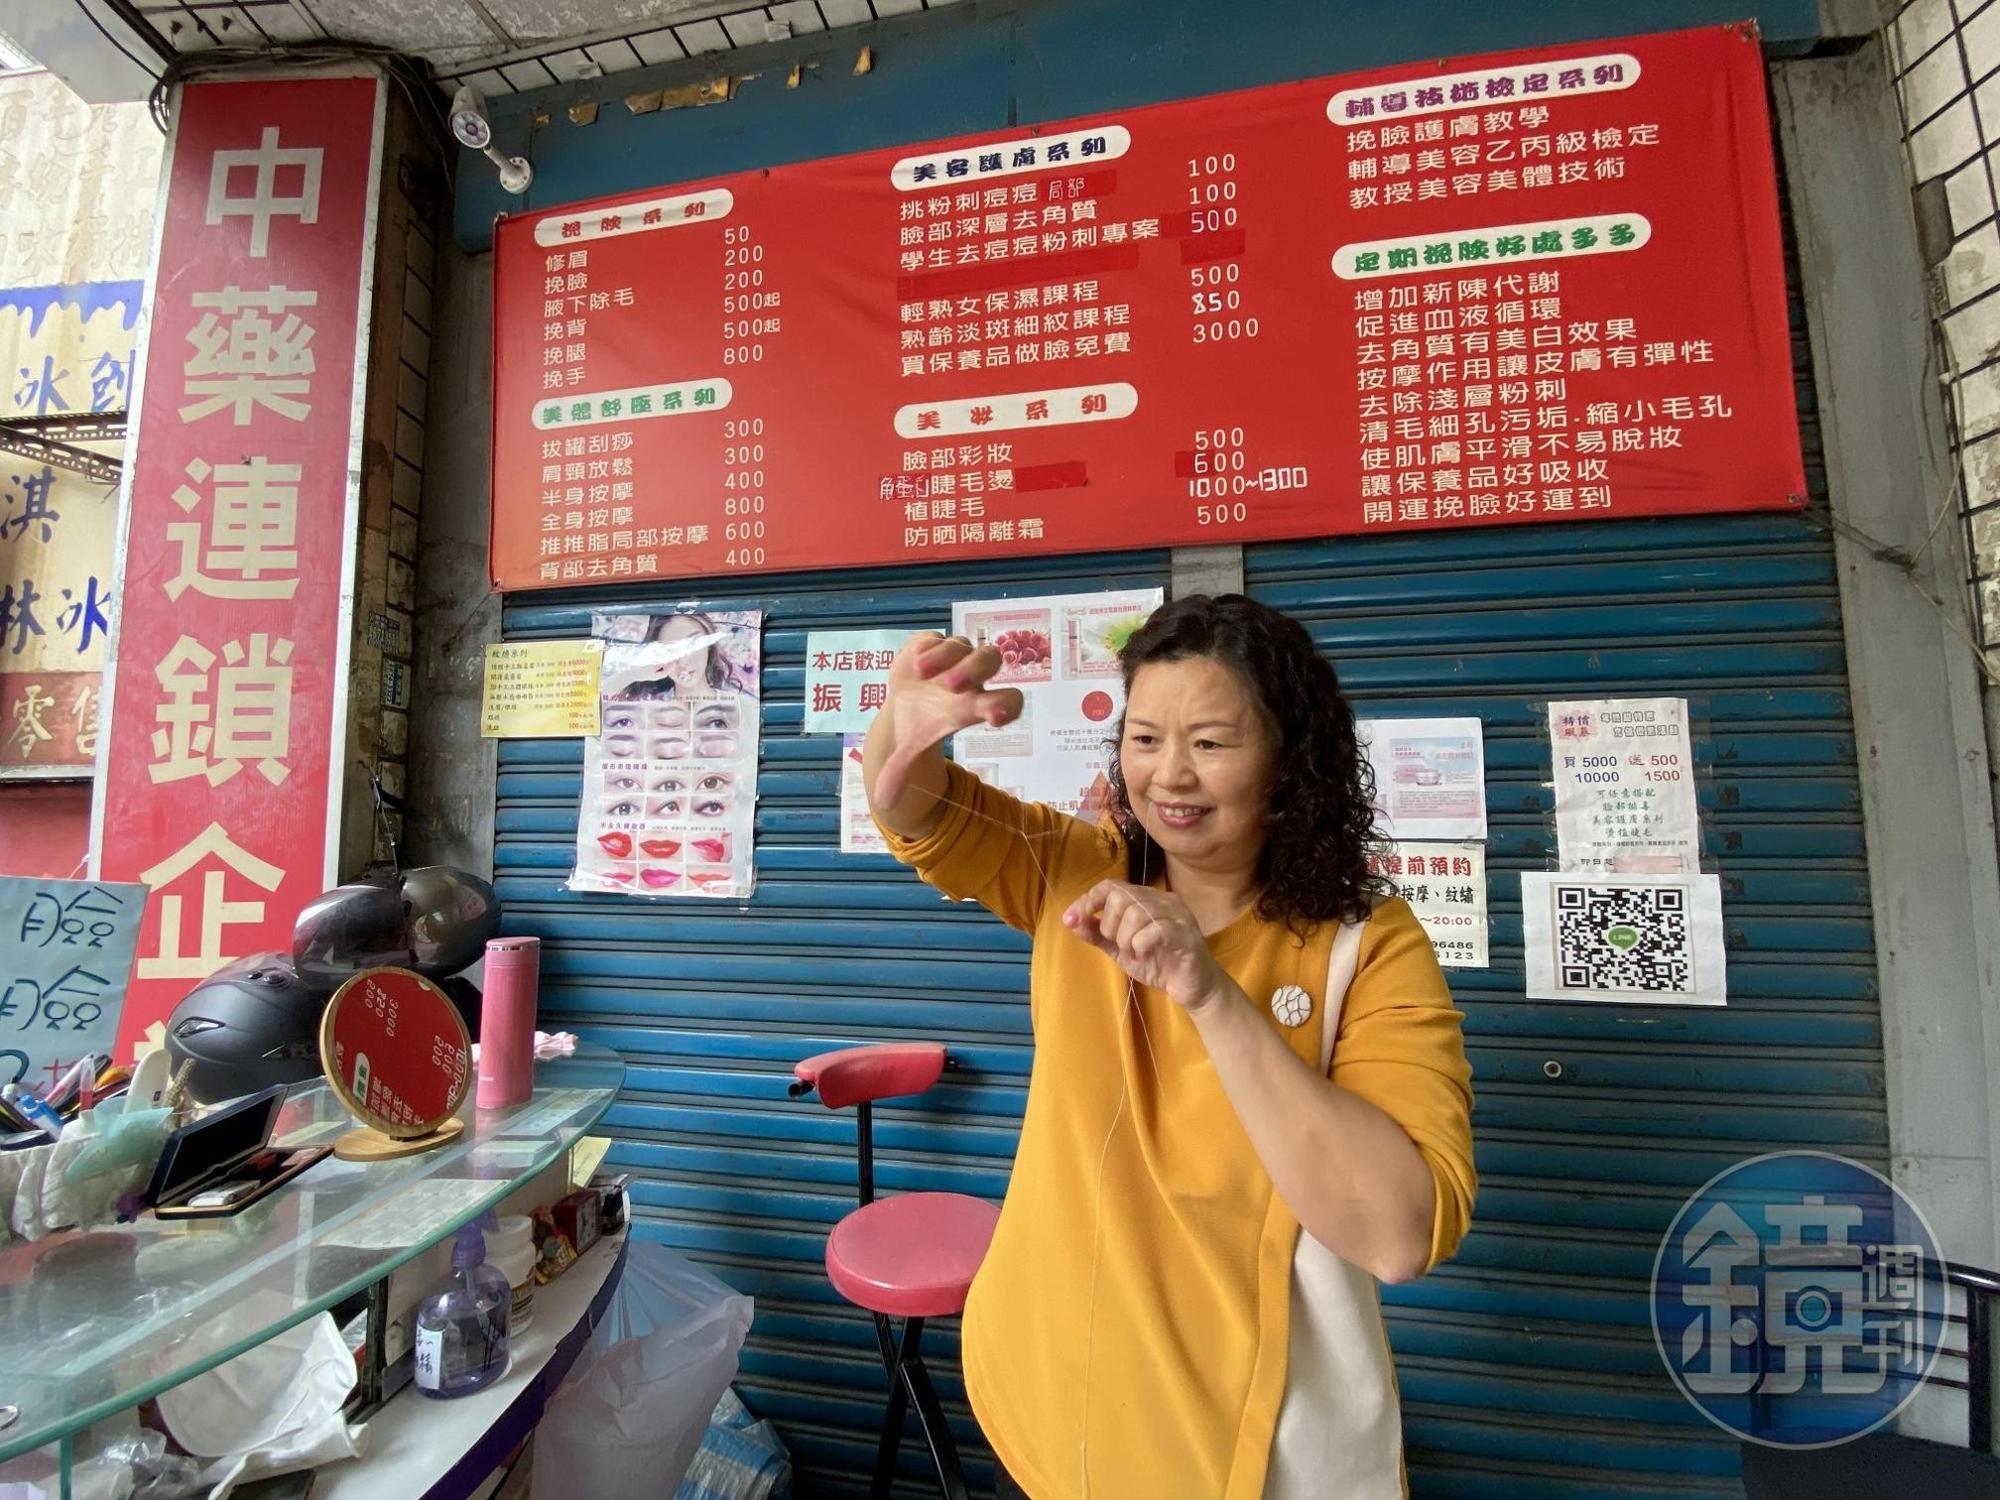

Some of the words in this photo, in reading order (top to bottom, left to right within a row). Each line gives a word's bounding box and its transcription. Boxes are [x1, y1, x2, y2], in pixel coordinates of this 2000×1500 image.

[1347, 106, 1550, 152] 挽臉護膚教學
[913, 136, 1106, 182] 美容護膚系列
[1189, 153, 1236, 178] 100
[1348, 124, 1660, 181] 輔導美容乙丙級檢定
[1189, 182, 1237, 205] 100
[1349, 156, 1625, 209] 教授美容美體技術
[900, 201, 1098, 246] 臉部深層去角質
[1191, 207, 1237, 233] 500
[725, 226, 750, 245] 50
[900, 218, 1160, 272] 學生去痘痘粉刺專案
[1354, 223, 1636, 273] 定期挽臉好處多多
[545, 250, 588, 273] 修眉
[725, 246, 763, 266] 200
[544, 273, 588, 295] 挽臉
[725, 270, 763, 290] 200
[1191, 263, 1240, 287] 500
[544, 288, 635, 318] 腋下除毛
[724, 292, 781, 313] 500起
[901, 280, 1099, 324] 輕熟女保濕課程
[1354, 271, 1560, 311] 增加新陳代謝
[544, 319, 587, 341] 挽背
[723, 319, 781, 339] 500起
[901, 304, 1131, 350] 熟齡淡斑細紋課程
[1355, 297, 1562, 338] 促進血液循環
[1193, 318, 1259, 344] 3000
[1356, 318, 1637, 365] 去角質有美白效果
[543, 343, 586, 366] 挽腿
[723, 345, 763, 365] 800
[901, 331, 1131, 377] 買保養品做臉免費
[1357, 340, 1714, 391] 按摩作用讓皮膚有彈性
[543, 367, 586, 389] 挽手
[1358, 378, 1566, 418] 去除淺層粉刺
[724, 418, 764, 439] 300
[1195, 427, 1245, 451] 500
[542, 432, 633, 459] 拔罐刮痧
[725, 445, 764, 465] 300
[903, 443, 1013, 471] 臉部彩妝
[1360, 426, 1683, 471] 使肌膚平滑不易脫妝
[542, 457, 633, 483] 肩頸放鬆
[1194, 452, 1245, 475] 600
[725, 471, 764, 490] 400
[1361, 458, 1609, 498] 讓保養品好吸收
[542, 482, 633, 507] 半身按摩
[725, 496, 765, 515] 800
[1363, 485, 1612, 526] 開運挽臉好運到
[541, 506, 633, 532] 全身按摩
[904, 497, 985, 522] 植睫毛
[1198, 503, 1247, 525] 500
[540, 525, 709, 556] 推推脂局部按摩
[725, 521, 765, 541] 600
[904, 518, 1044, 547] 防晒隔離霜
[540, 554, 658, 580] 背部去角質
[726, 548, 766, 566] 400
[134, 126, 324, 1061] 中藥連鎖企
[812, 650, 895, 671] 本店歡迎
[812, 683, 887, 712] 振興
[1583, 756, 1617, 767] 5000
[1629, 755, 1645, 766] 送
[1651, 755, 1678, 766] 500
[1575, 772, 1620, 783] 10000
[1645, 770, 1680, 782] 1500
